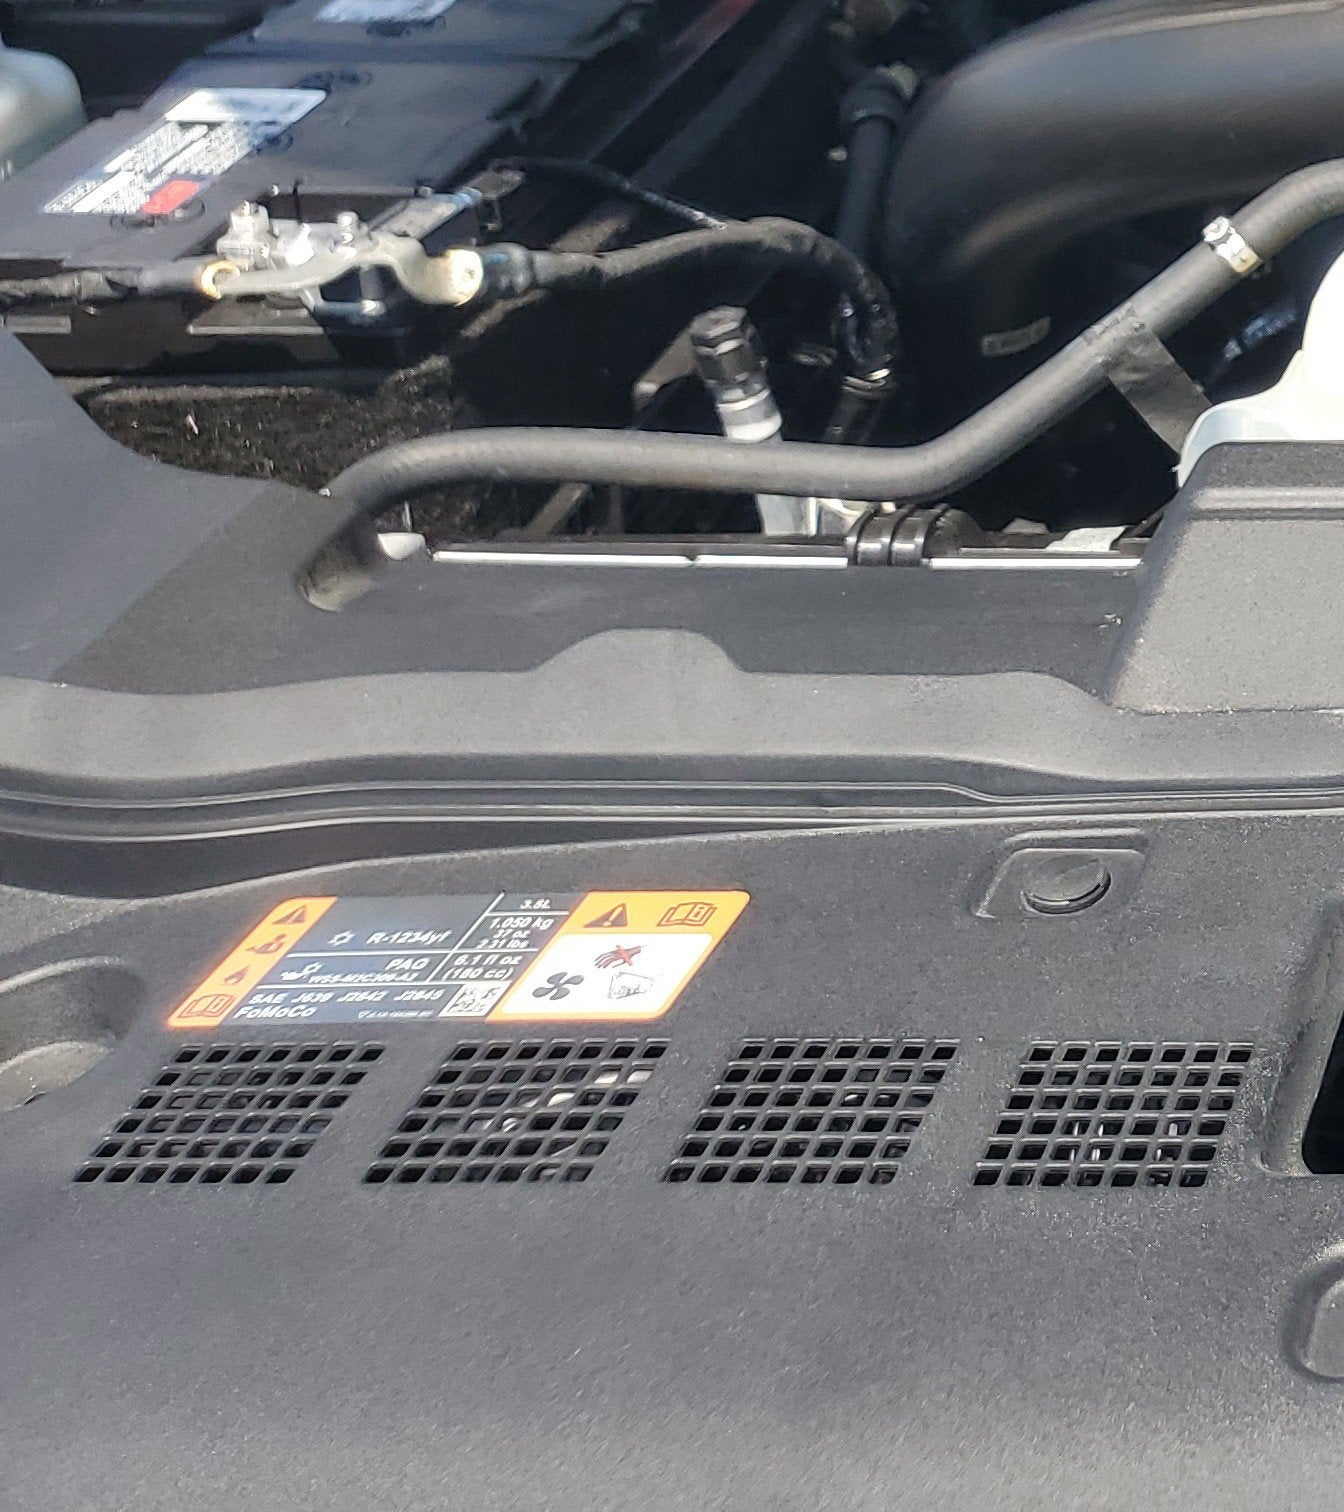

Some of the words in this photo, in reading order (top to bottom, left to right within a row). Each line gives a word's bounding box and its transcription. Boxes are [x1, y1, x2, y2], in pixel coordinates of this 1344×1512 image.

[488, 916, 532, 930] 1.050
[532, 916, 555, 931] kg
[366, 930, 452, 945] R-1234yf
[385, 957, 431, 970] PAG
[453, 954, 482, 966] 6.1
[248, 992, 288, 1005] SAE
[232, 1004, 319, 1020] FoMoCo
